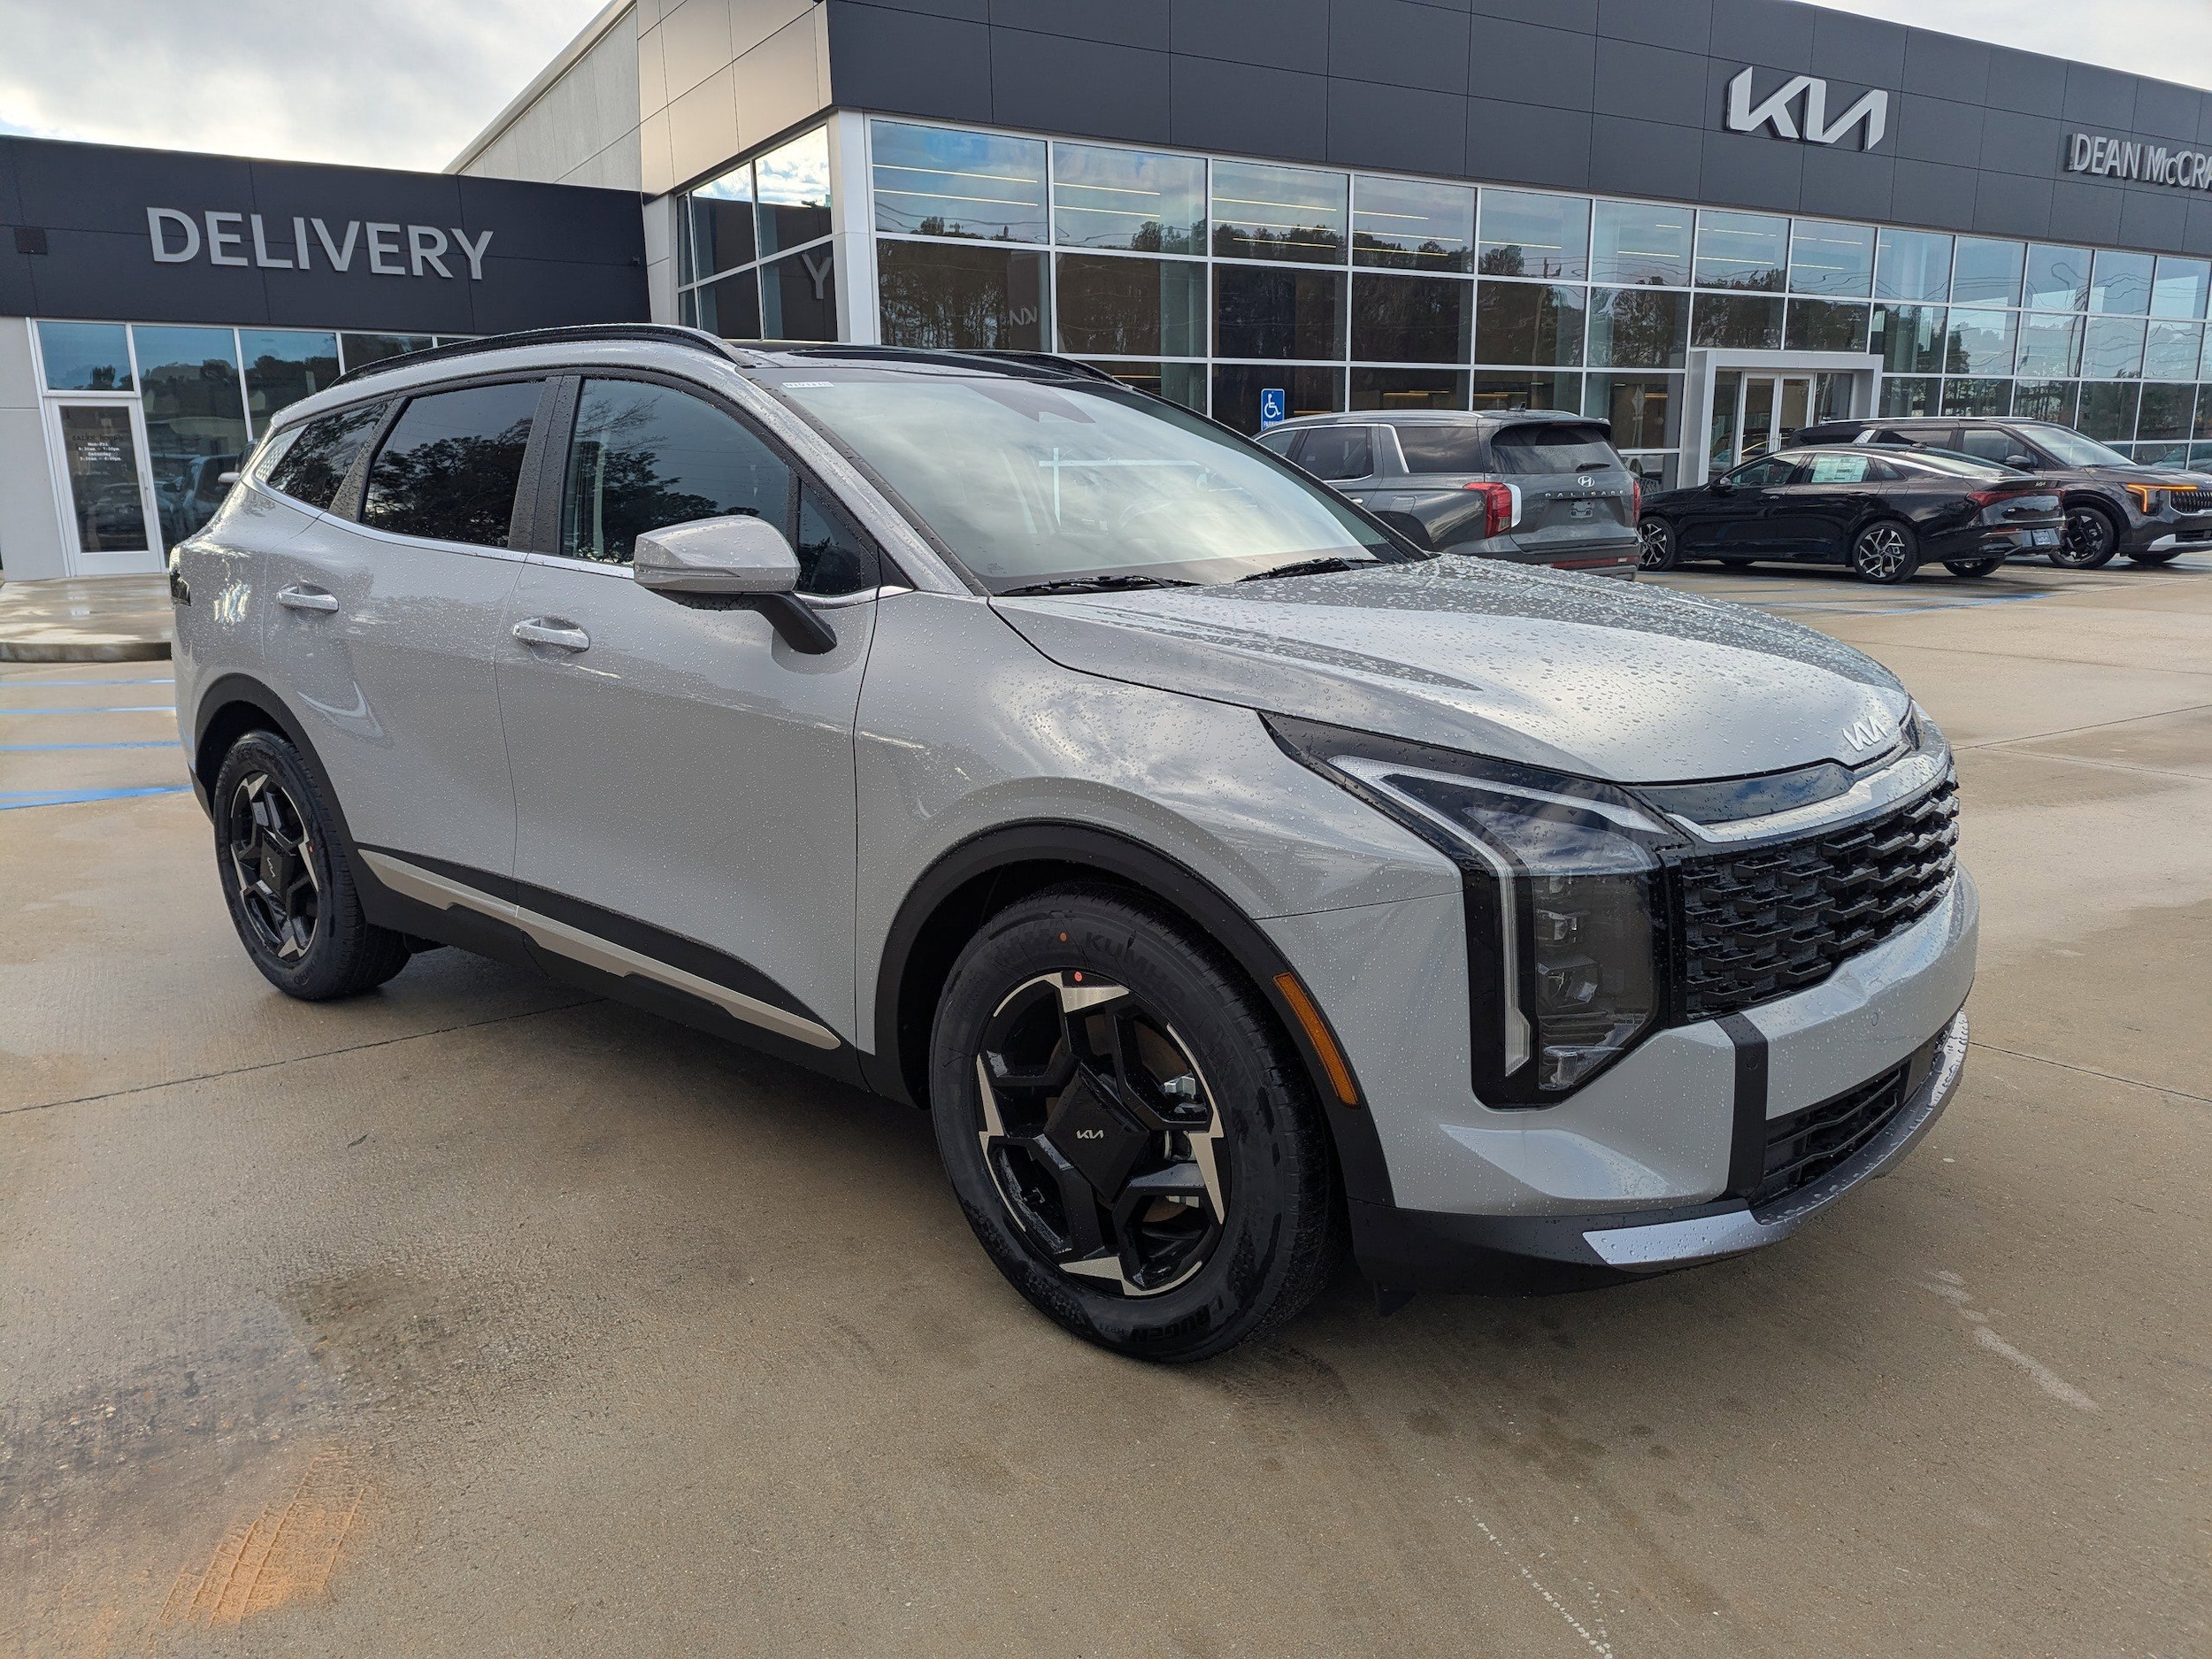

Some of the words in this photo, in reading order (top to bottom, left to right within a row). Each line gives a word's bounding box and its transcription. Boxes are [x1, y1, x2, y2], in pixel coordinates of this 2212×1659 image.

[1727, 65, 1888, 150] KIA
[2070, 133, 2141, 179] DEAN
[147, 206, 494, 280] DELIVERY
[1842, 716, 1887, 751] KIA
[1086, 931, 1186, 1002] KUMHO
[1076, 1129, 1104, 1139] KIA
